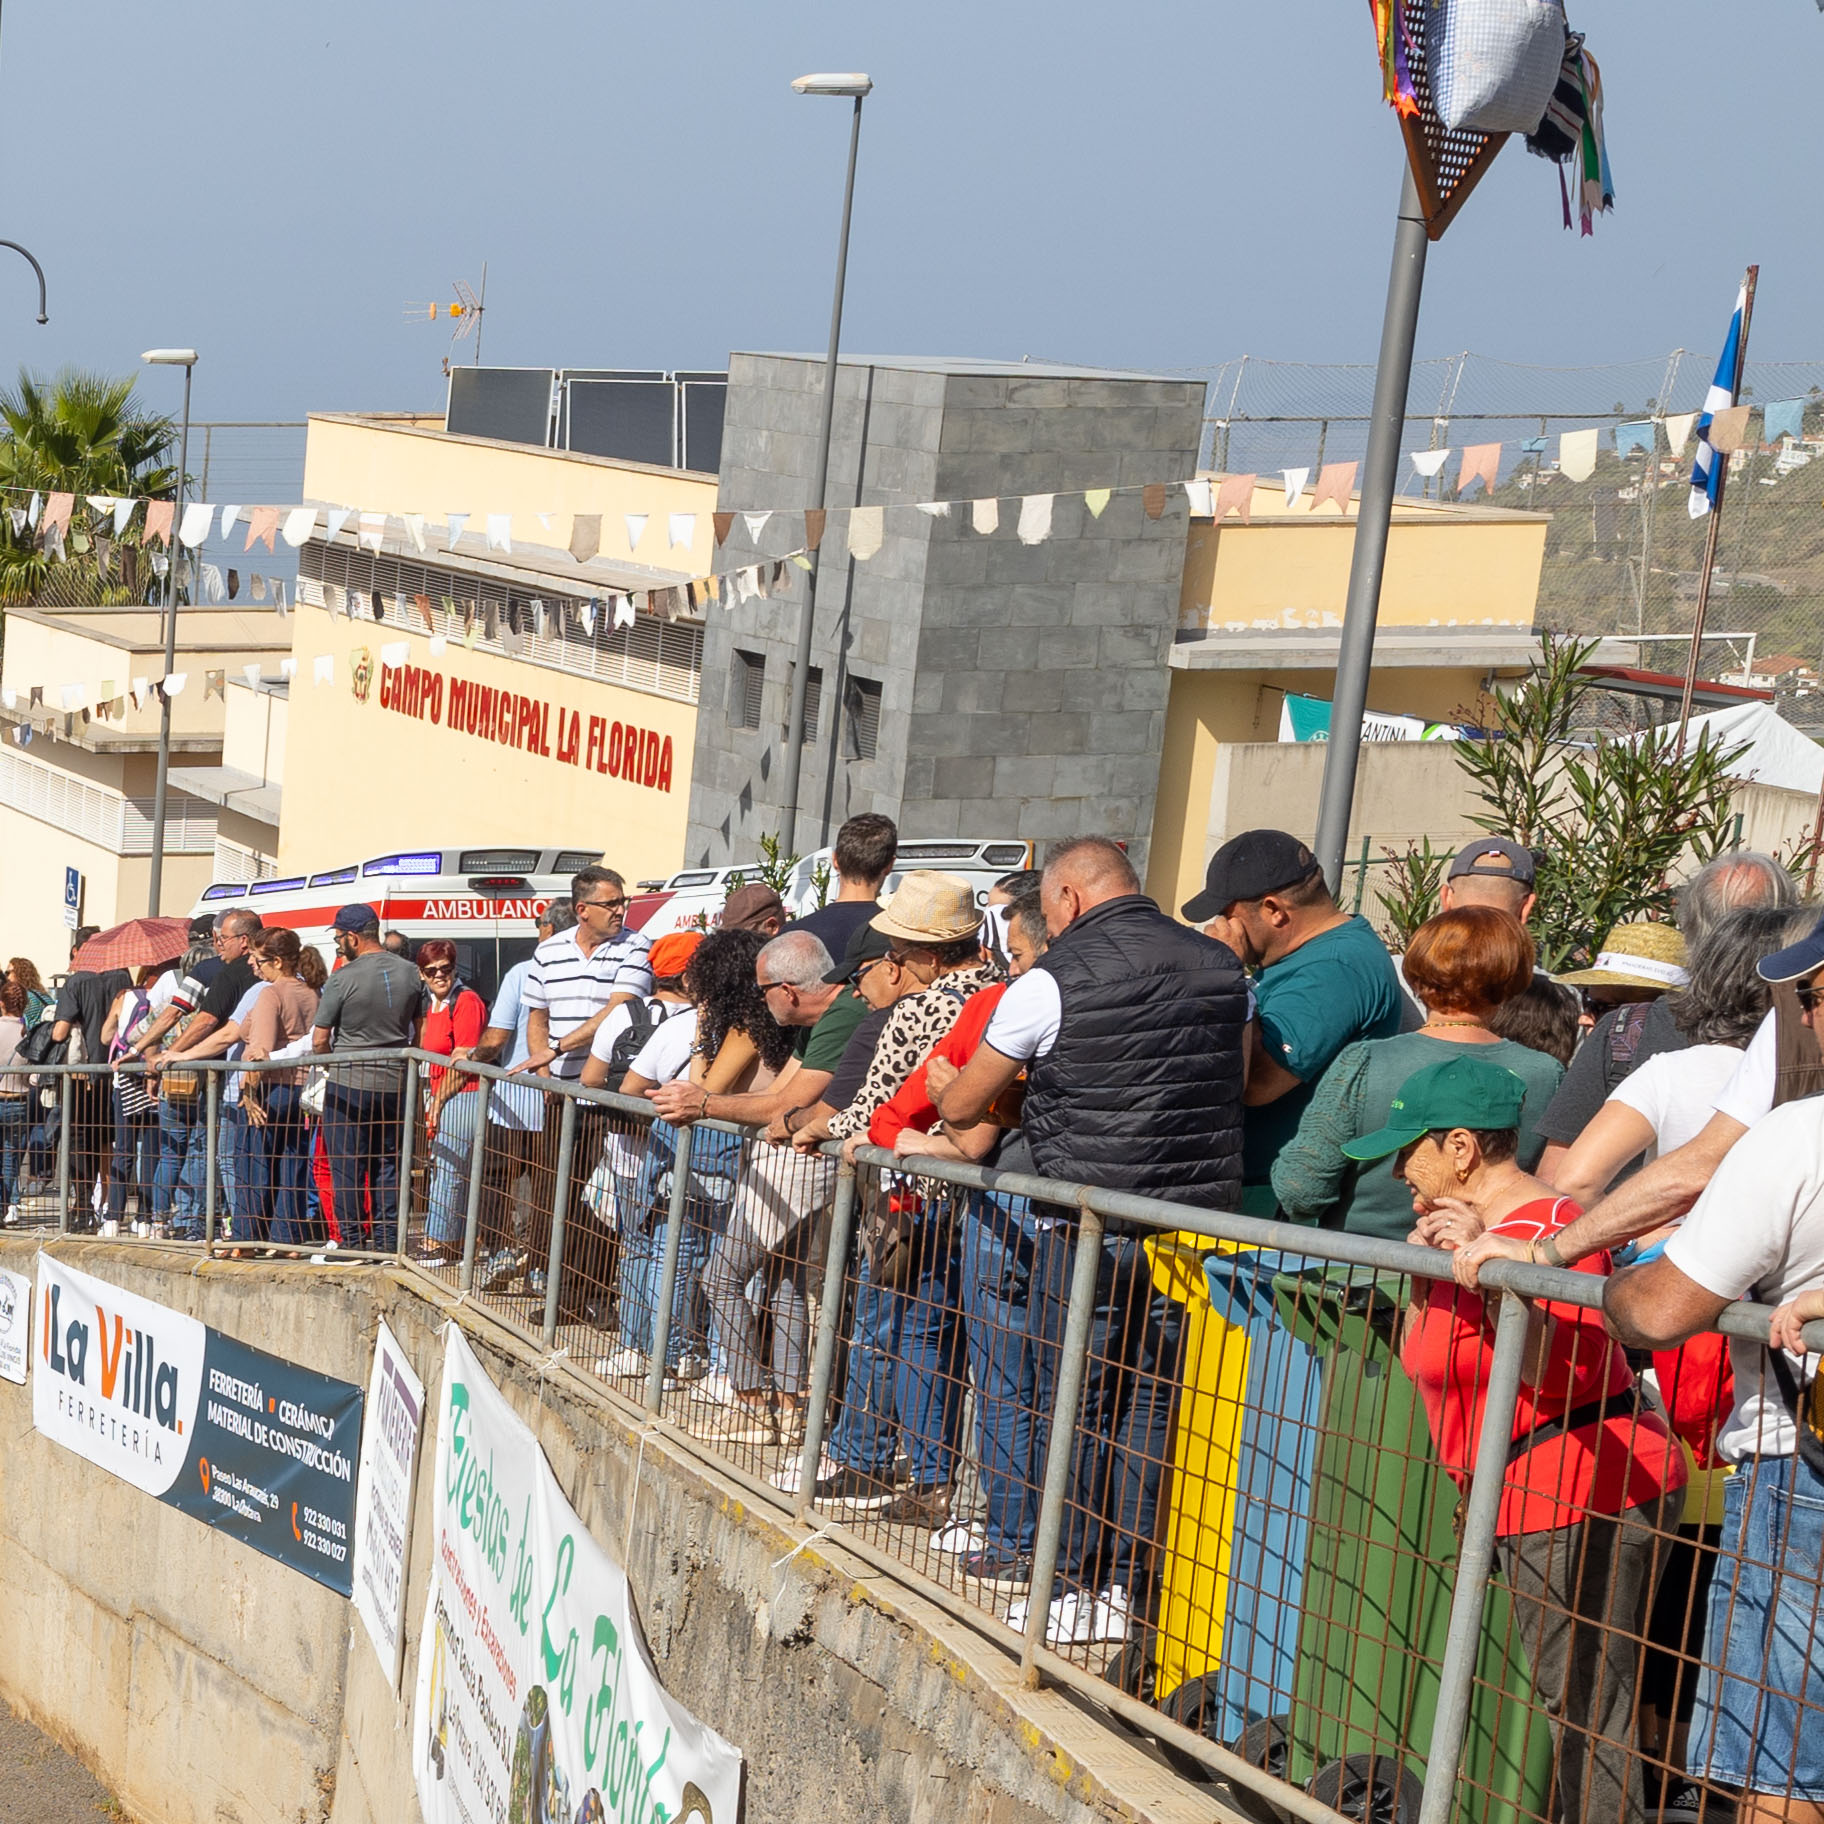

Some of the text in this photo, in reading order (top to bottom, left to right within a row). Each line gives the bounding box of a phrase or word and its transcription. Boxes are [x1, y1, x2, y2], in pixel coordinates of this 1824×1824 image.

[379, 661, 673, 793] CAMPO MUNICIPAL LA FLORIDA
[1362, 722, 1407, 741] ANTINA
[422, 899, 554, 920] AMBULANC
[50, 1283, 89, 1386] La
[208, 1368, 264, 1414] FERRETERÍA
[58, 1390, 163, 1465] FERRETERÍA
[207, 1400, 253, 1445] MATERIAL
[253, 1422, 269, 1449] DE
[269, 1427, 351, 1482] CONSTRUCCIÓN
[232, 1472, 243, 1490] Las
[303, 1506, 347, 1540] 922 330 031
[303, 1531, 347, 1562] 922 330 027
[447, 1382, 510, 1584] Fiestas
[509, 1494, 534, 1636] de
[541, 1534, 579, 1719] La
